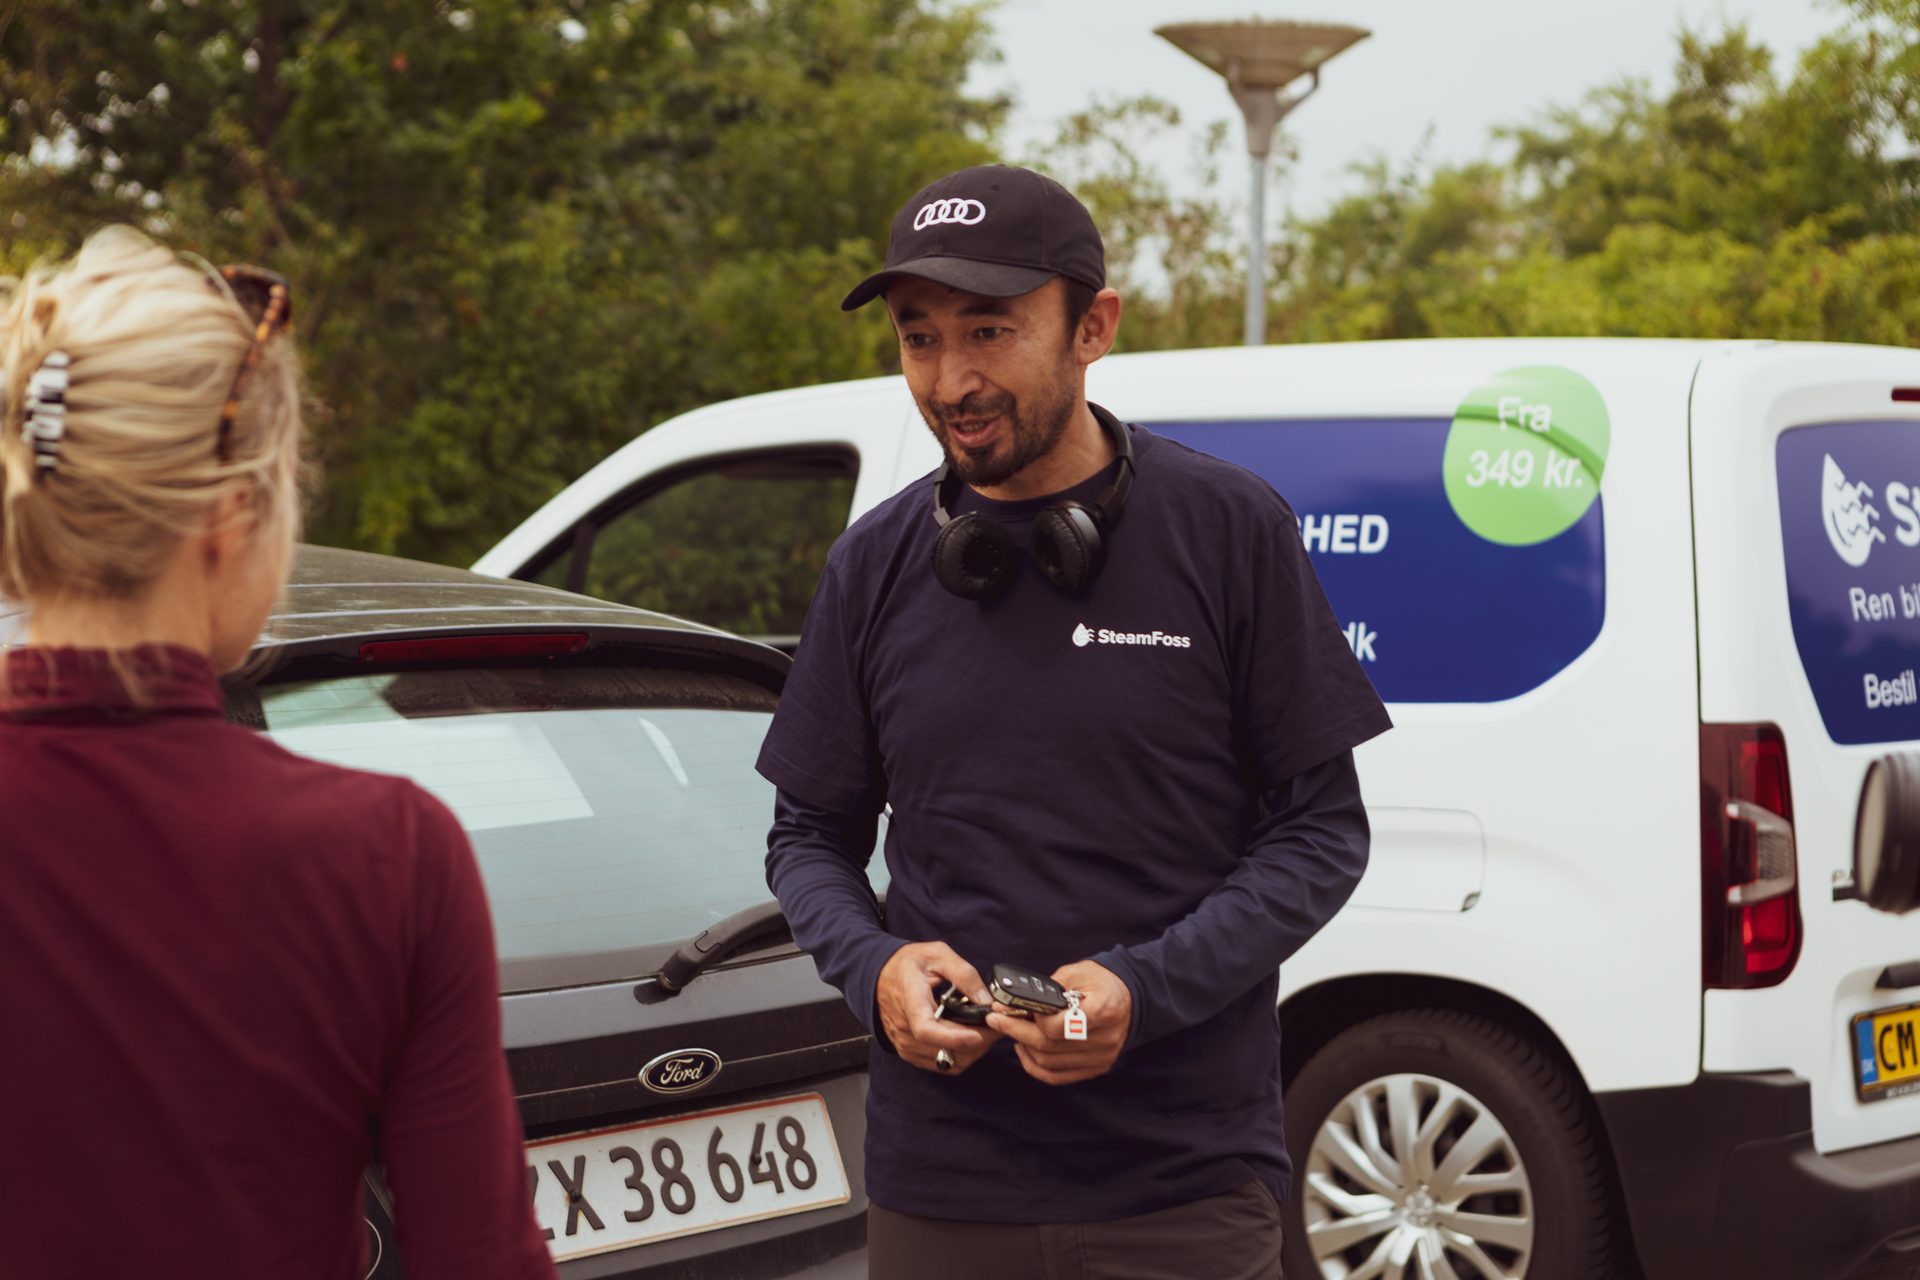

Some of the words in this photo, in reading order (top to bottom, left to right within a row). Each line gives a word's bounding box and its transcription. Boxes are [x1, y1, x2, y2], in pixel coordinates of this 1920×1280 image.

[1497, 396, 1553, 432] Fra
[1465, 449, 1535, 489] 349
[1542, 448, 1585, 489] kr.
[1295, 514, 1390, 555] HED
[1848, 586, 1896, 623] Ren
[1898, 582, 1920, 620] bi
[1097, 628, 1191, 649] SteamFoss
[1862, 668, 1918, 710] Bestil
[1878, 1020, 1918, 1072] CM
[659, 1057, 705, 1085] Ford
[608, 1137, 696, 1223] 38
[706, 1115, 818, 1204] 648
